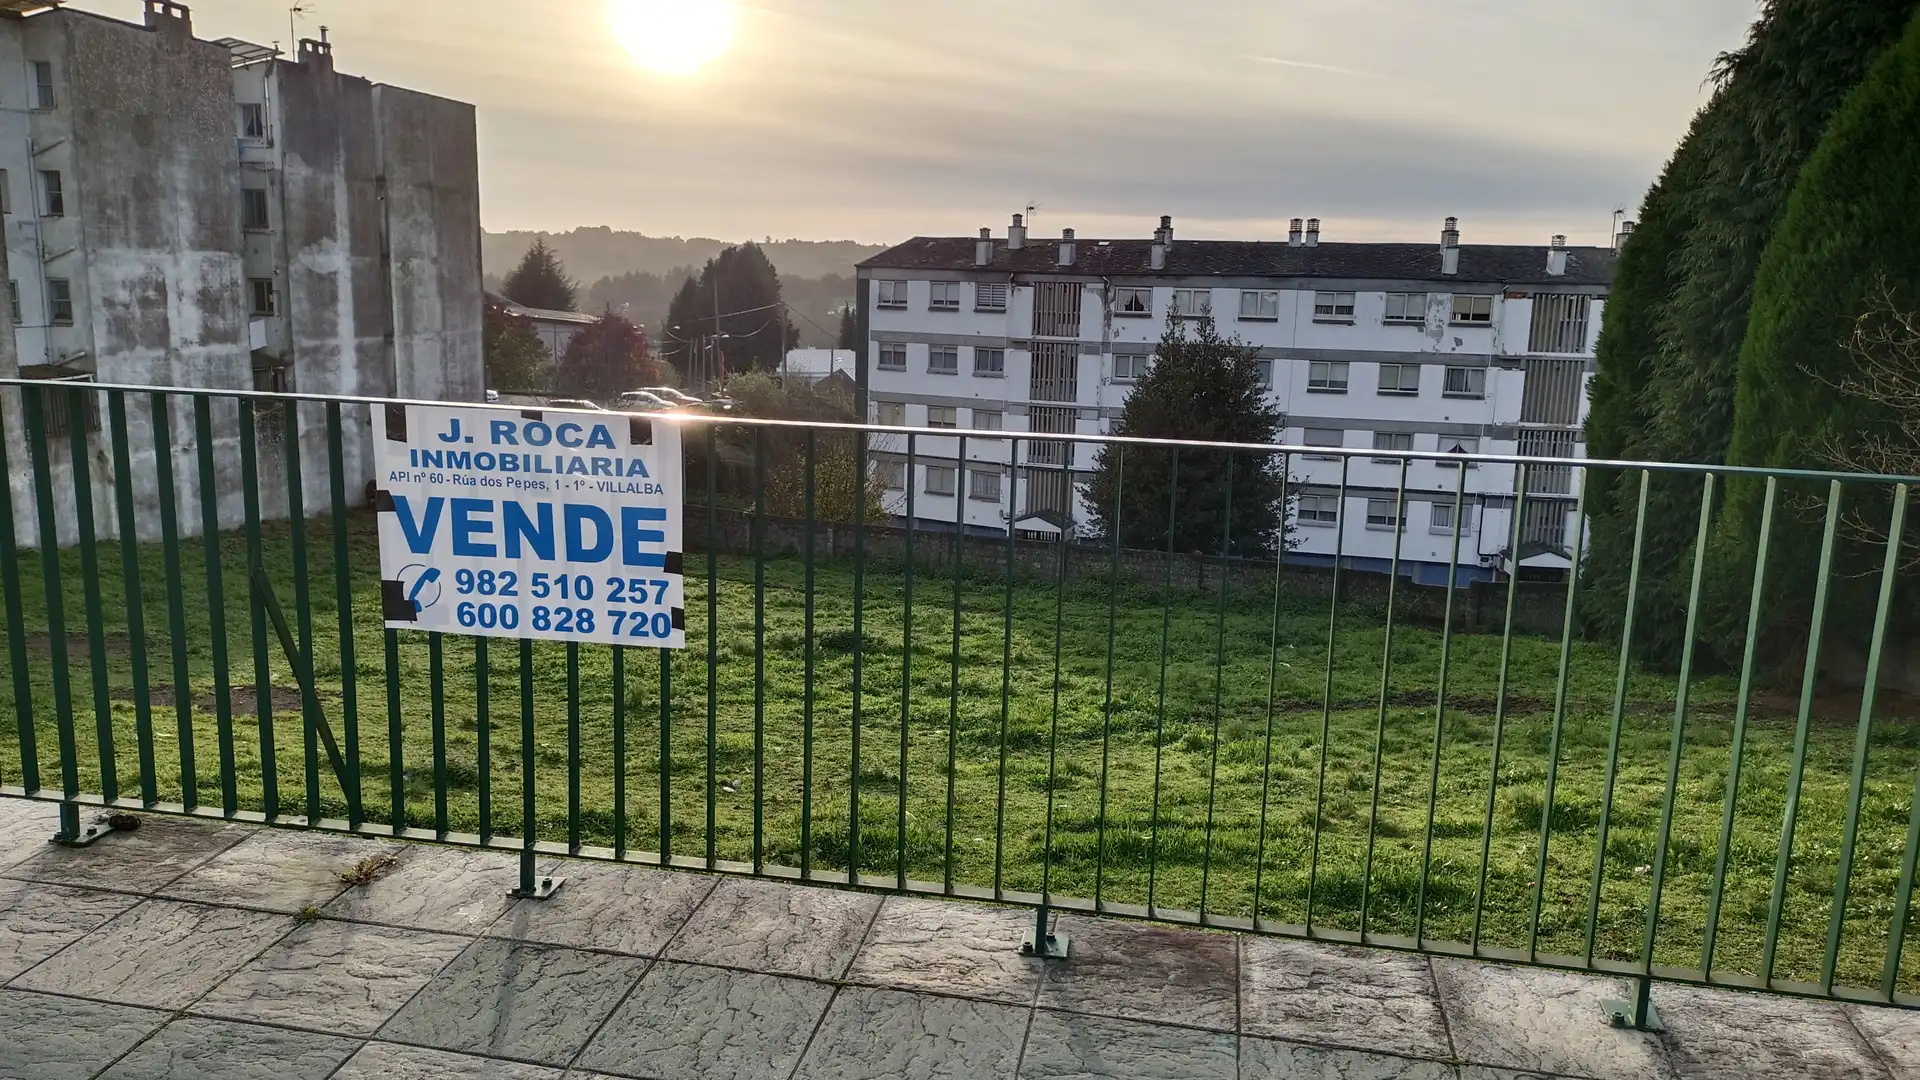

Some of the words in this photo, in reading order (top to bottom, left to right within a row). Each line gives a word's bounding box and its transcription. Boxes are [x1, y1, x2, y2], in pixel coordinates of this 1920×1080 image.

[438, 419, 474, 444] J.
[490, 420, 616, 449] ROCA
[410, 449, 650, 478] INMOBILIARIA
[389, 471, 410, 482] API
[414, 472, 426, 483] nº
[430, 474, 443, 484] 60
[453, 472, 476, 486] Rúa
[481, 476, 502, 487] dos
[507, 478, 549, 491] Pepes,
[555, 480, 559, 490] 1
[574, 480, 585, 491] 1º
[597, 481, 663, 494] VILLALBA
[391, 495, 667, 567] VENDE
[455, 568, 518, 597] 982
[531, 572, 594, 601] 510
[606, 577, 669, 605] 257
[457, 601, 519, 629] 600
[532, 606, 595, 634] 828
[608, 610, 671, 638] 720
